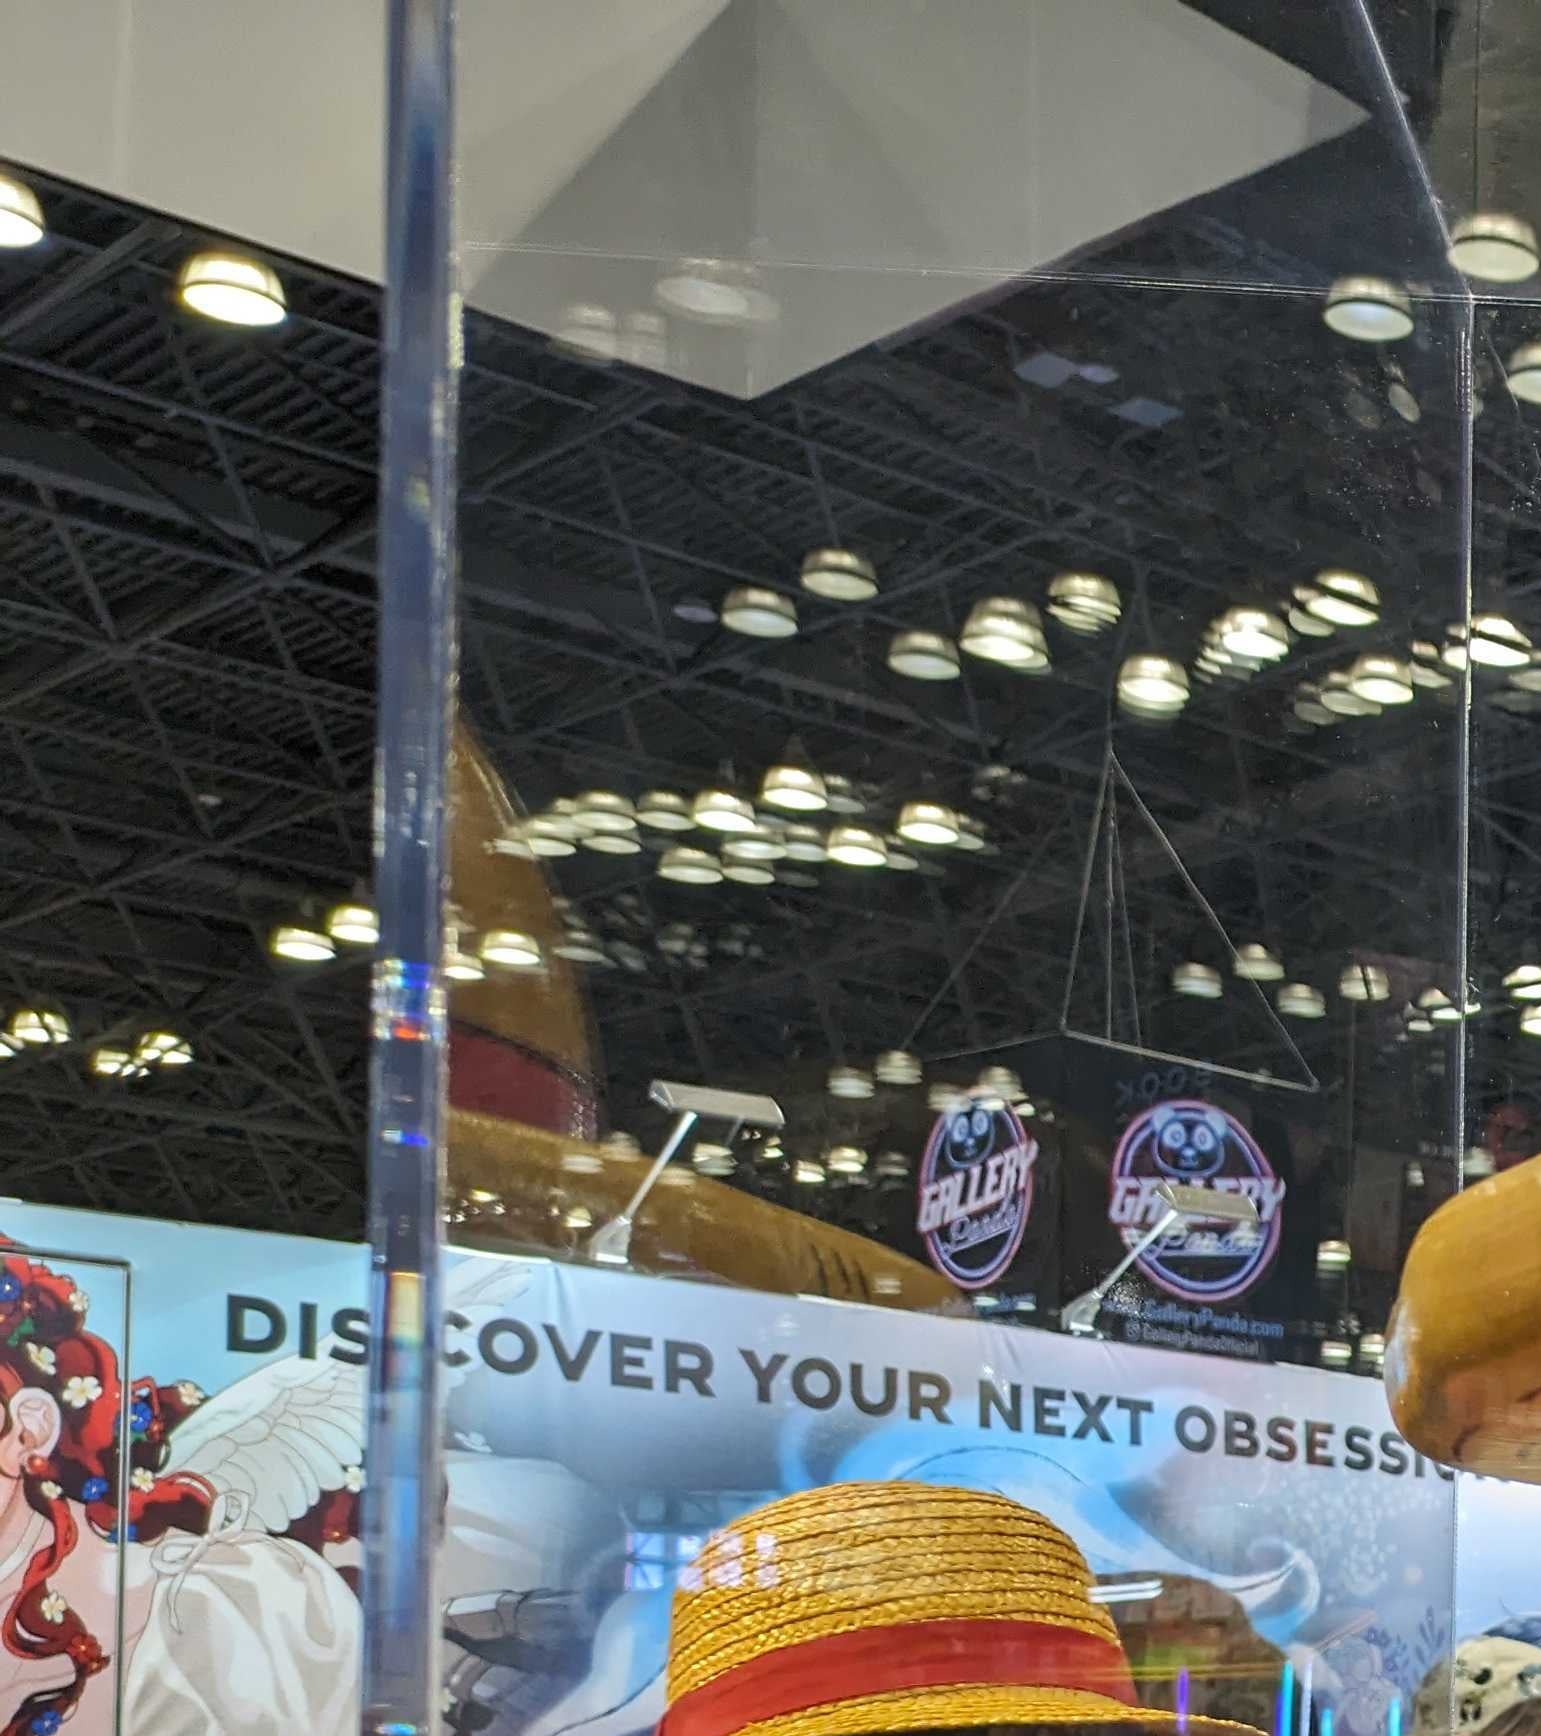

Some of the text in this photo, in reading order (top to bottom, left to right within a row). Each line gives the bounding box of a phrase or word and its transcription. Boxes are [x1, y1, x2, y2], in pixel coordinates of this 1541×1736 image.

[917, 1138, 1040, 1233] GALLERY
[1109, 1176, 1287, 1226] GARY
[738, 1346, 953, 1426] YOUR
[979, 1381, 1155, 1447] NEXT
[1175, 1404, 1510, 1483] OBSESSI
